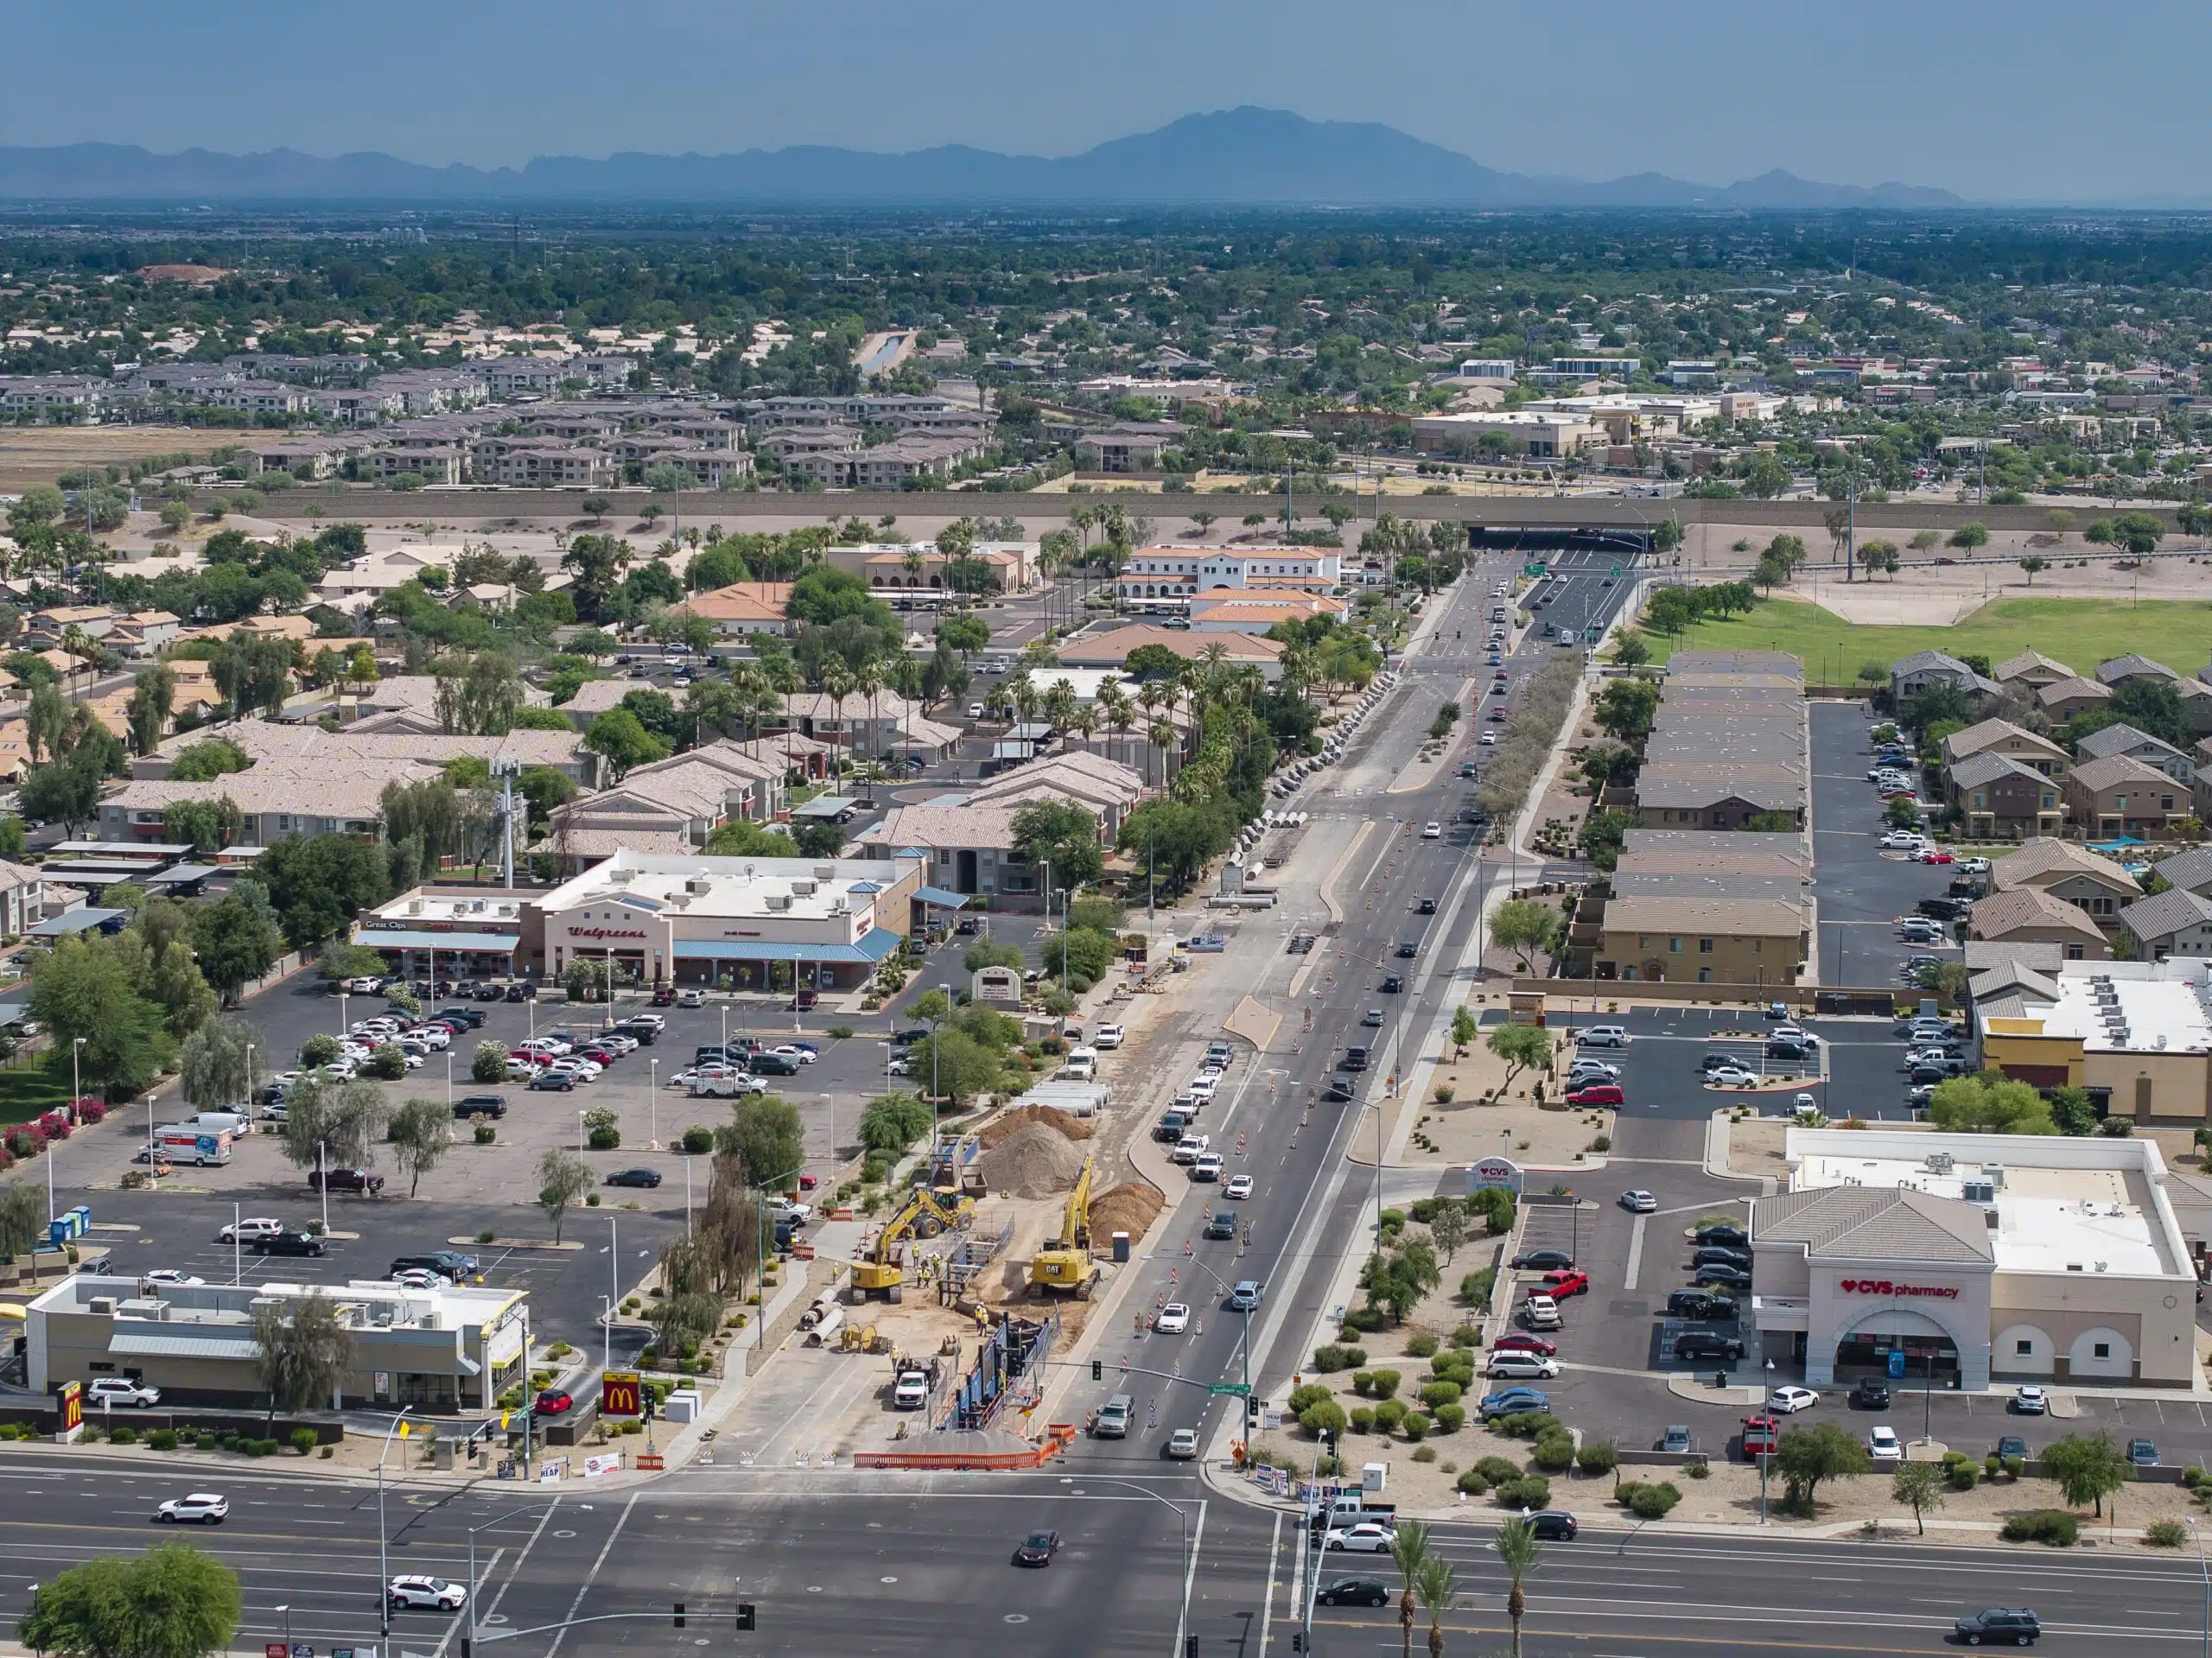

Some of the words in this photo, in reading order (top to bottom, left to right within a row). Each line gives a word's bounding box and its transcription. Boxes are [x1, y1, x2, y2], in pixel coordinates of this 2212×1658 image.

[365, 920, 387, 929] Great
[389, 921, 407, 930] Clips
[567, 926, 647, 940] Walgreens
[1489, 1167, 1509, 1176] CVS
[1046, 1264, 1059, 1274] CAT
[1858, 1280, 1893, 1294] CVS
[1895, 1284, 1959, 1299] pharmacy
[541, 1468, 559, 1477] HEAP
